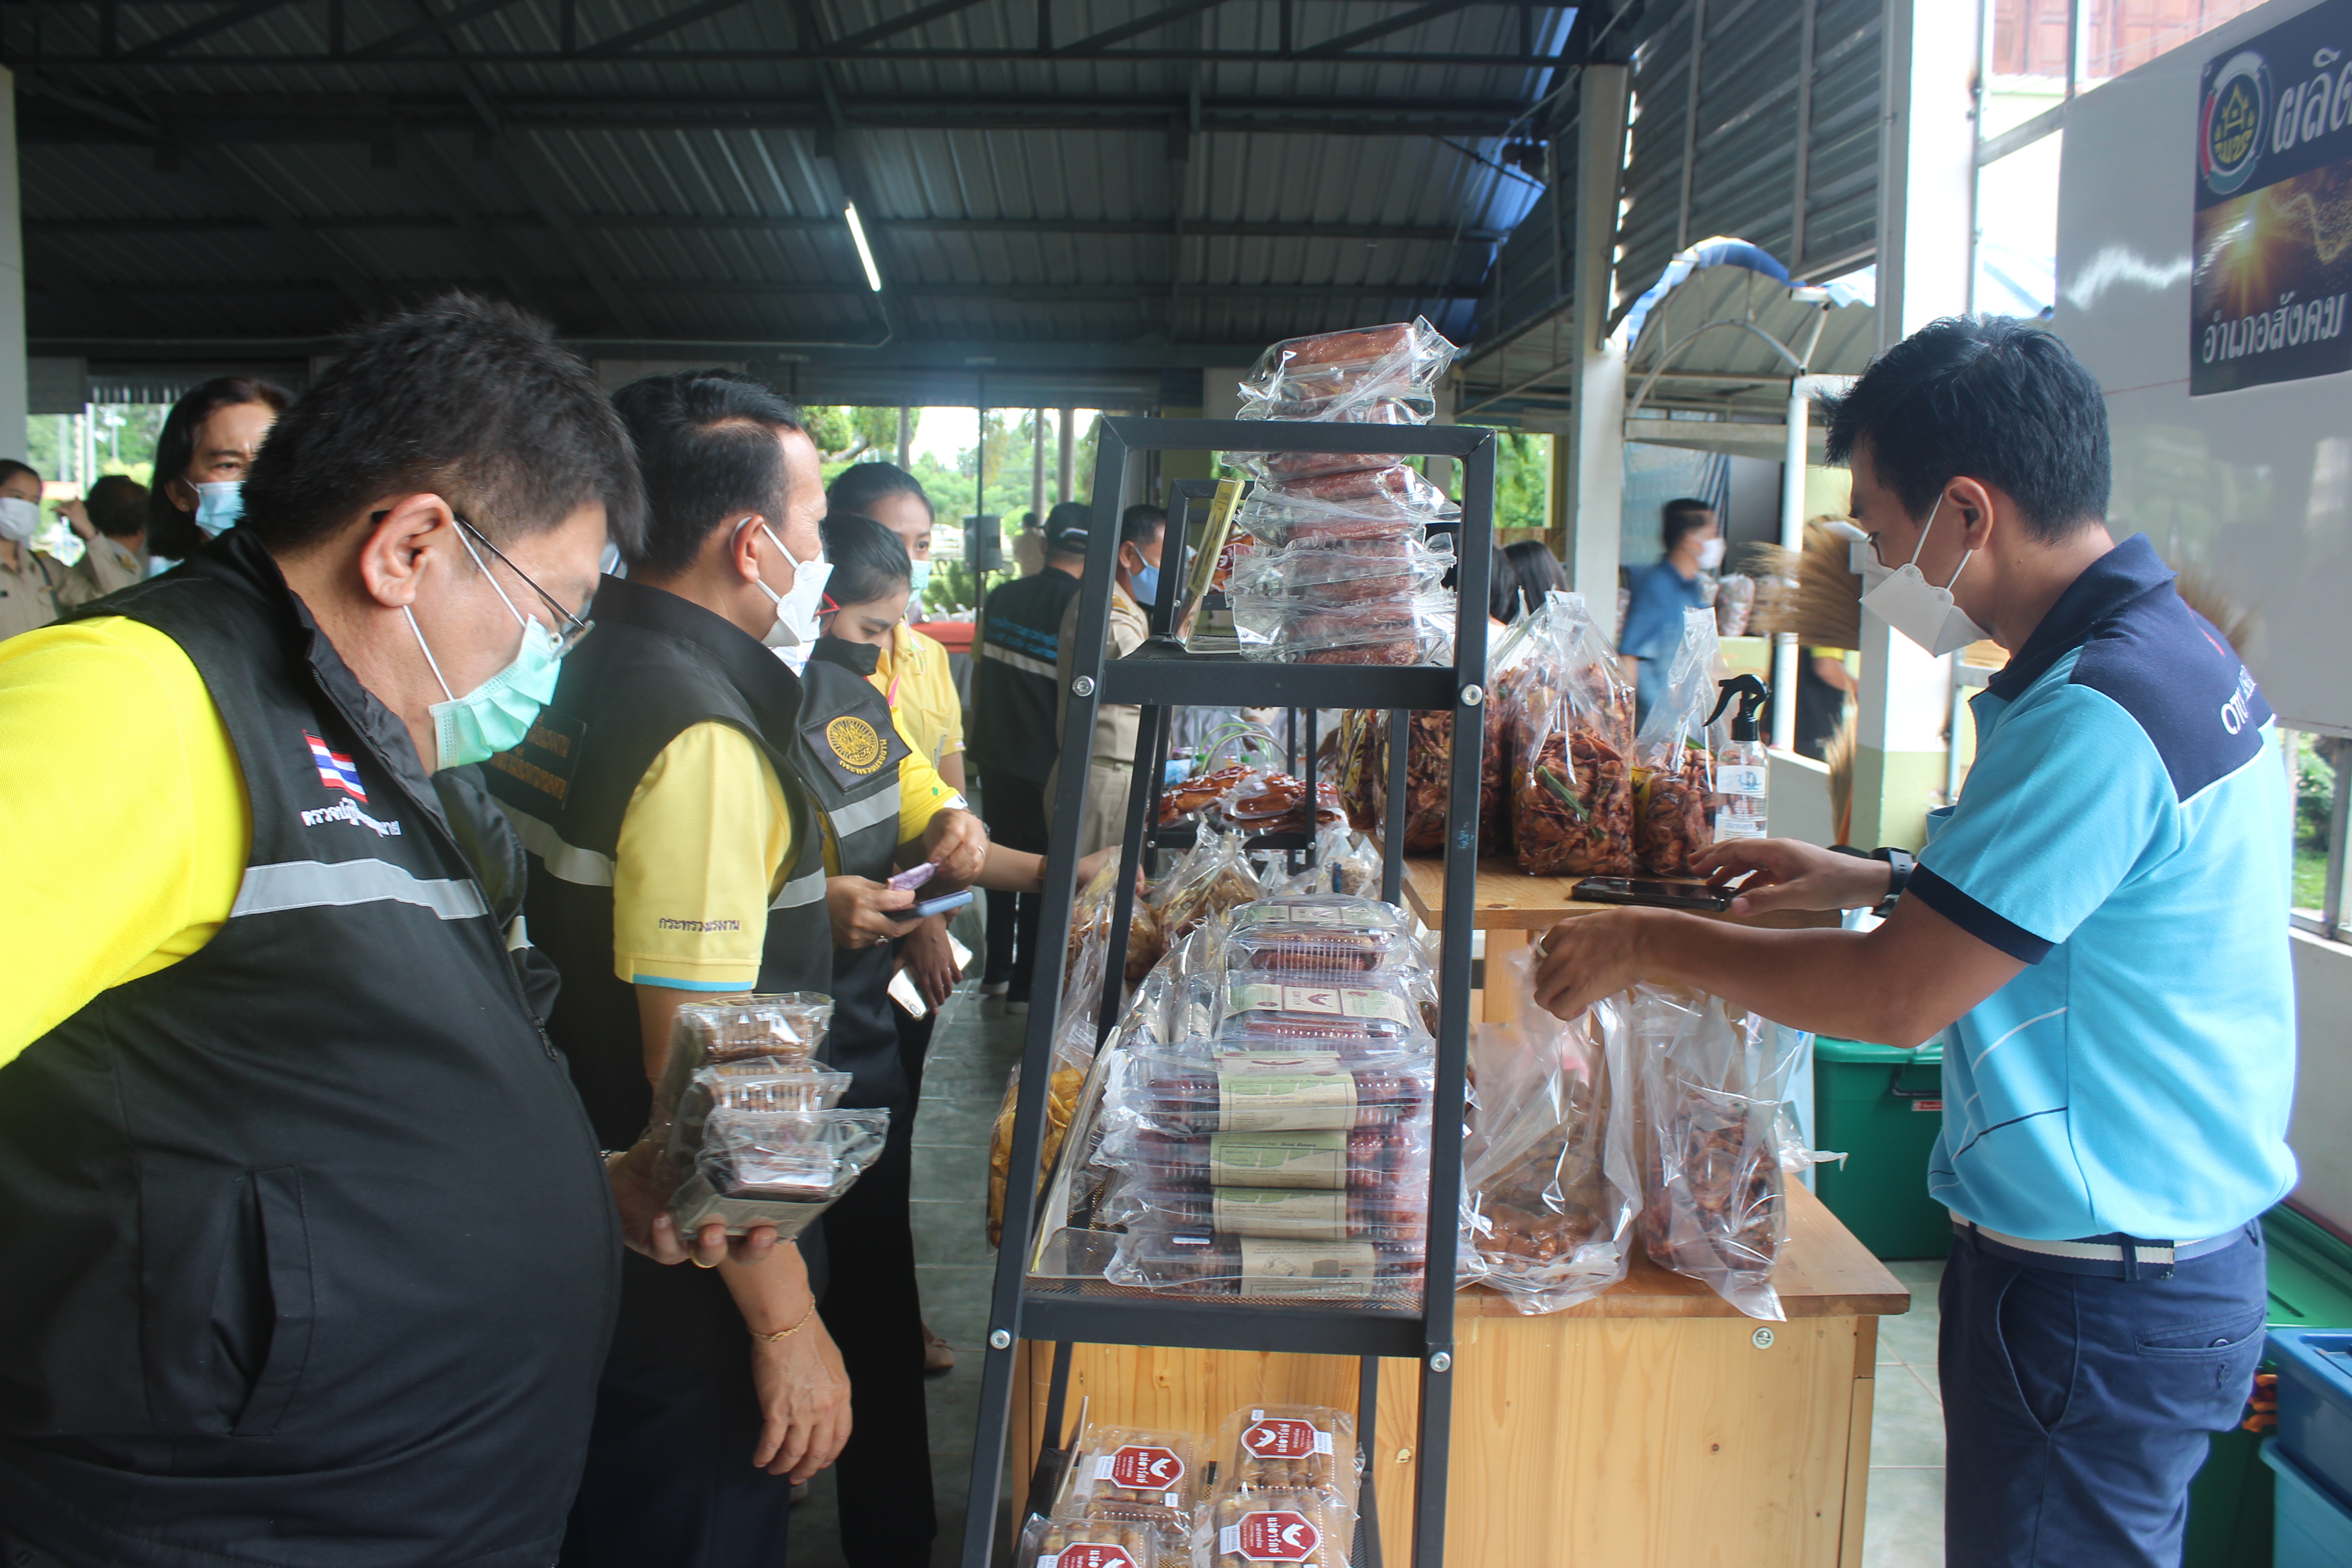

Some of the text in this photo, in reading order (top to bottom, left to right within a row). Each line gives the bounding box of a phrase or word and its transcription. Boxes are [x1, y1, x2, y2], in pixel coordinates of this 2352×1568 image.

[2203, 290, 2348, 363] อำเภอสังคม
[839, 738, 888, 775] กระทรวงแรงงาน
[1135, 1451, 1151, 1484] แม่อารักษ์
[1266, 1516, 1283, 1553] แม่อารักษ์
